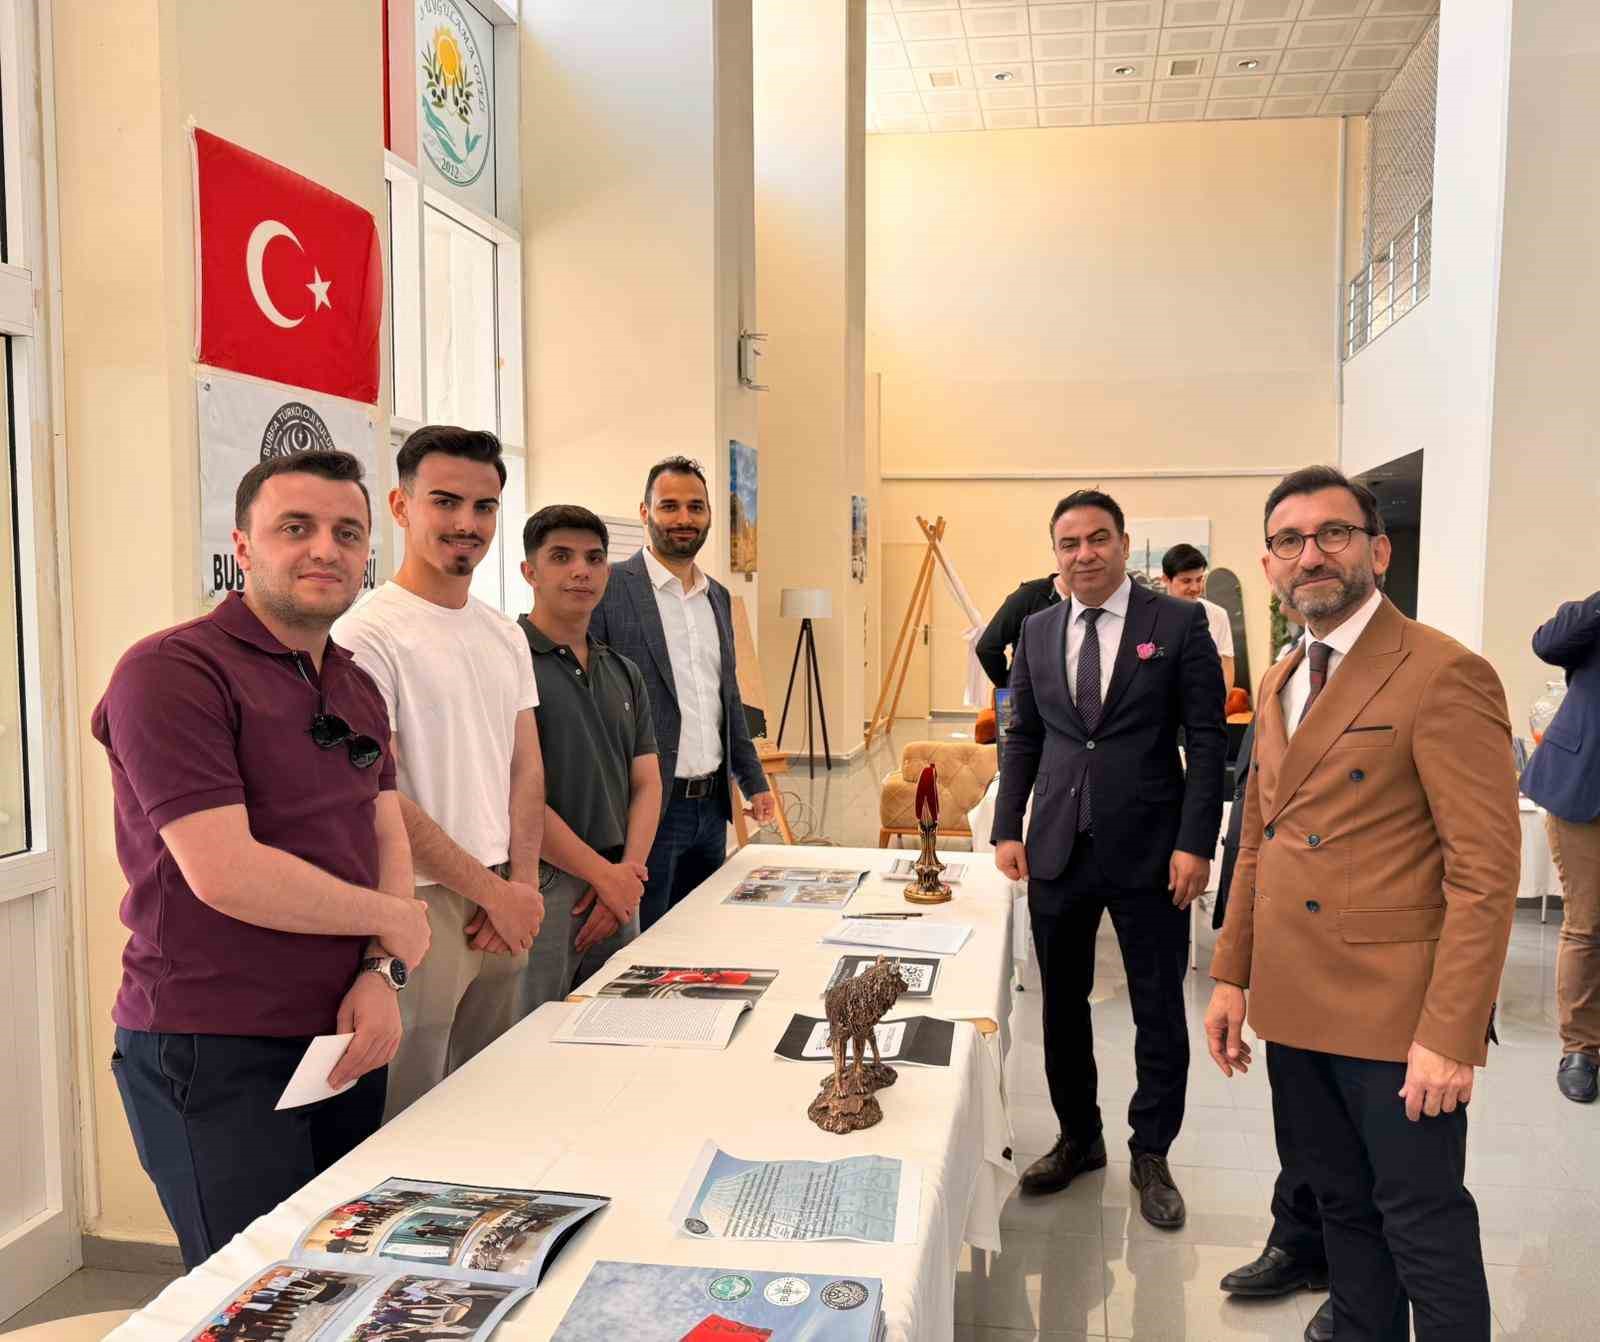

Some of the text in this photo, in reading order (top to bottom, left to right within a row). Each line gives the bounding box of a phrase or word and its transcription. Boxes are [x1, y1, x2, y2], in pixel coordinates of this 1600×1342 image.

[441, 157, 460, 179] 2012
[262, 420, 280, 457] BUBFA
[213, 553, 245, 592] BUB
